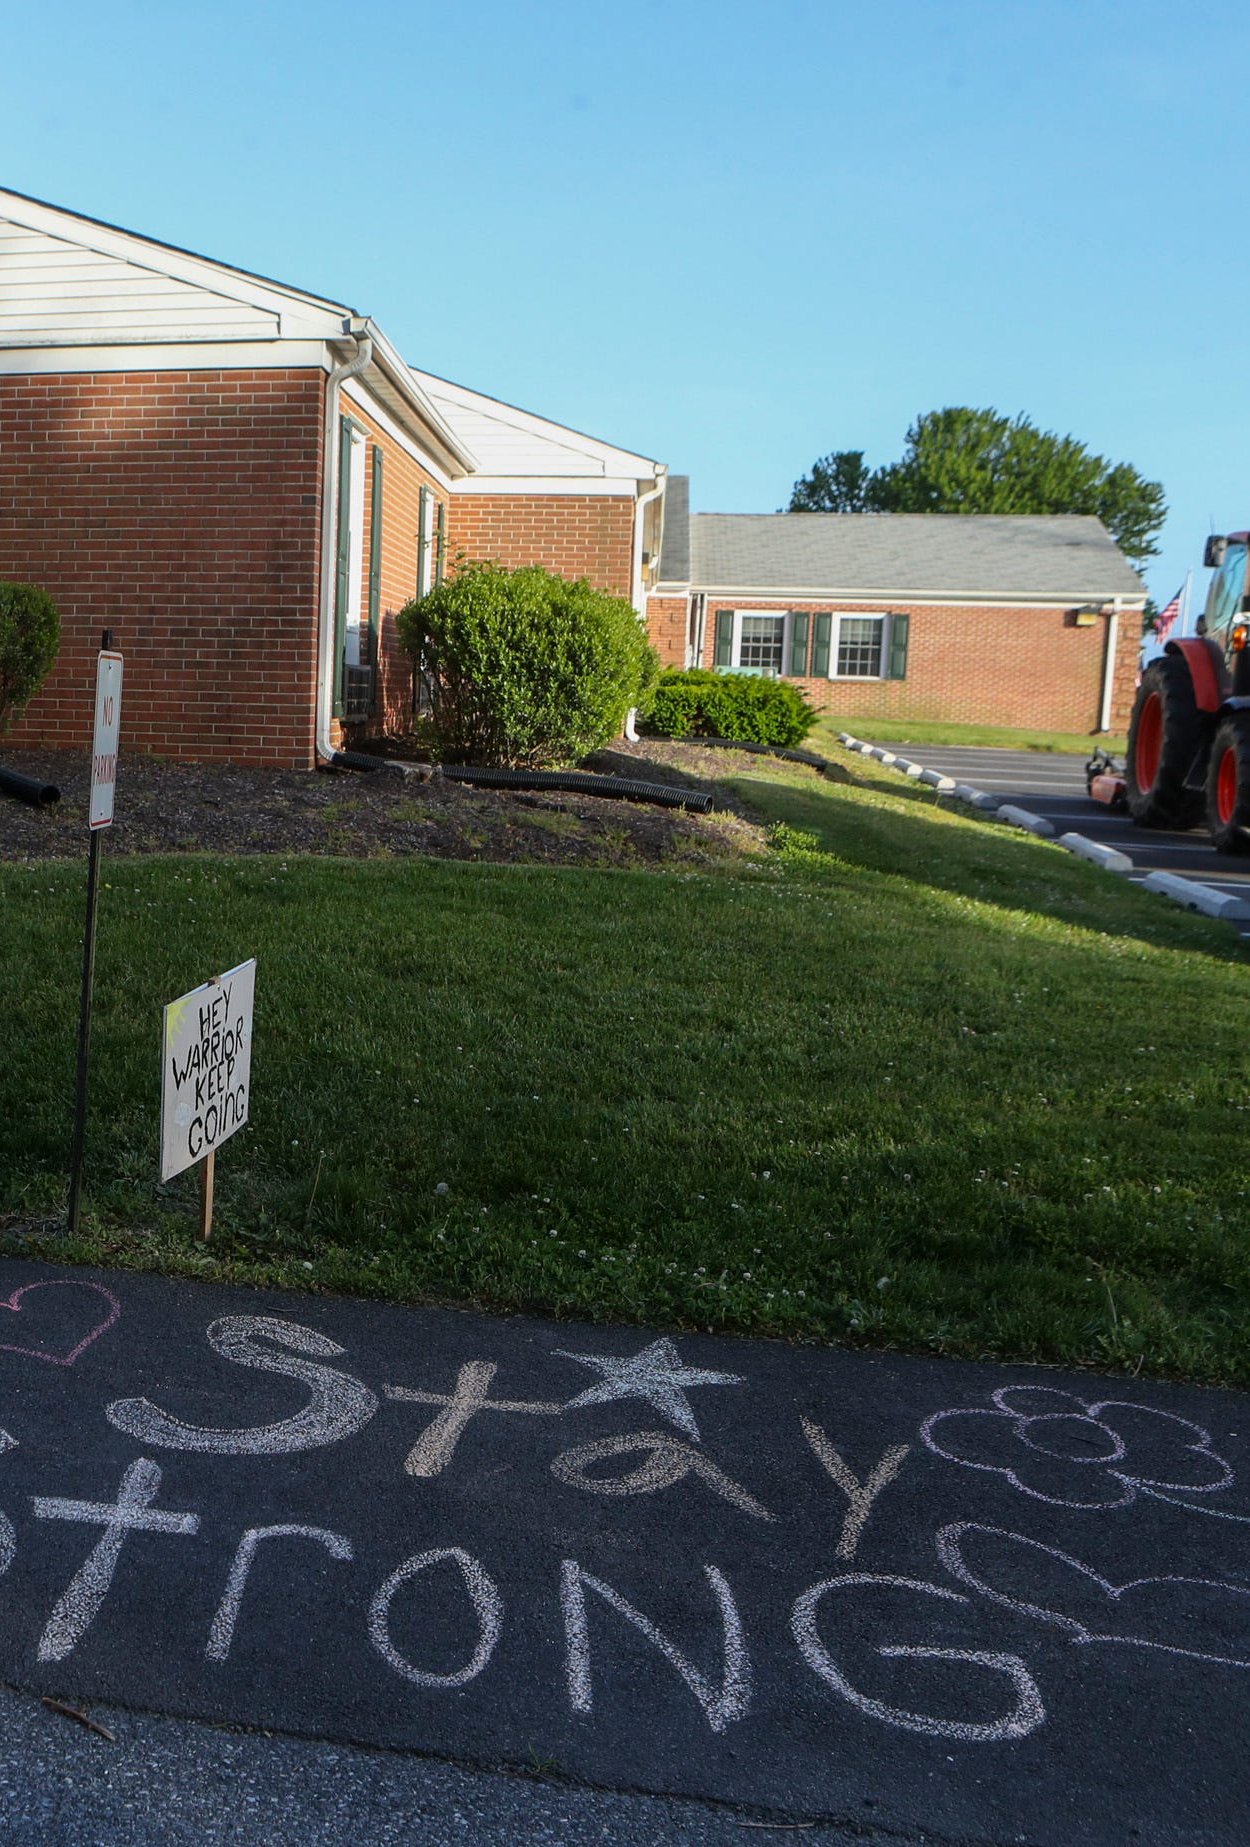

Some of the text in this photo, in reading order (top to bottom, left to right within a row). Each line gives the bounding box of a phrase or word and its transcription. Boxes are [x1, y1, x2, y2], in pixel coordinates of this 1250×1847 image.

[103, 695, 114, 727] NO
[94, 754, 117, 785] PARKING
[199, 982, 232, 1041] HEY
[195, 1056, 235, 1111] KEEP
